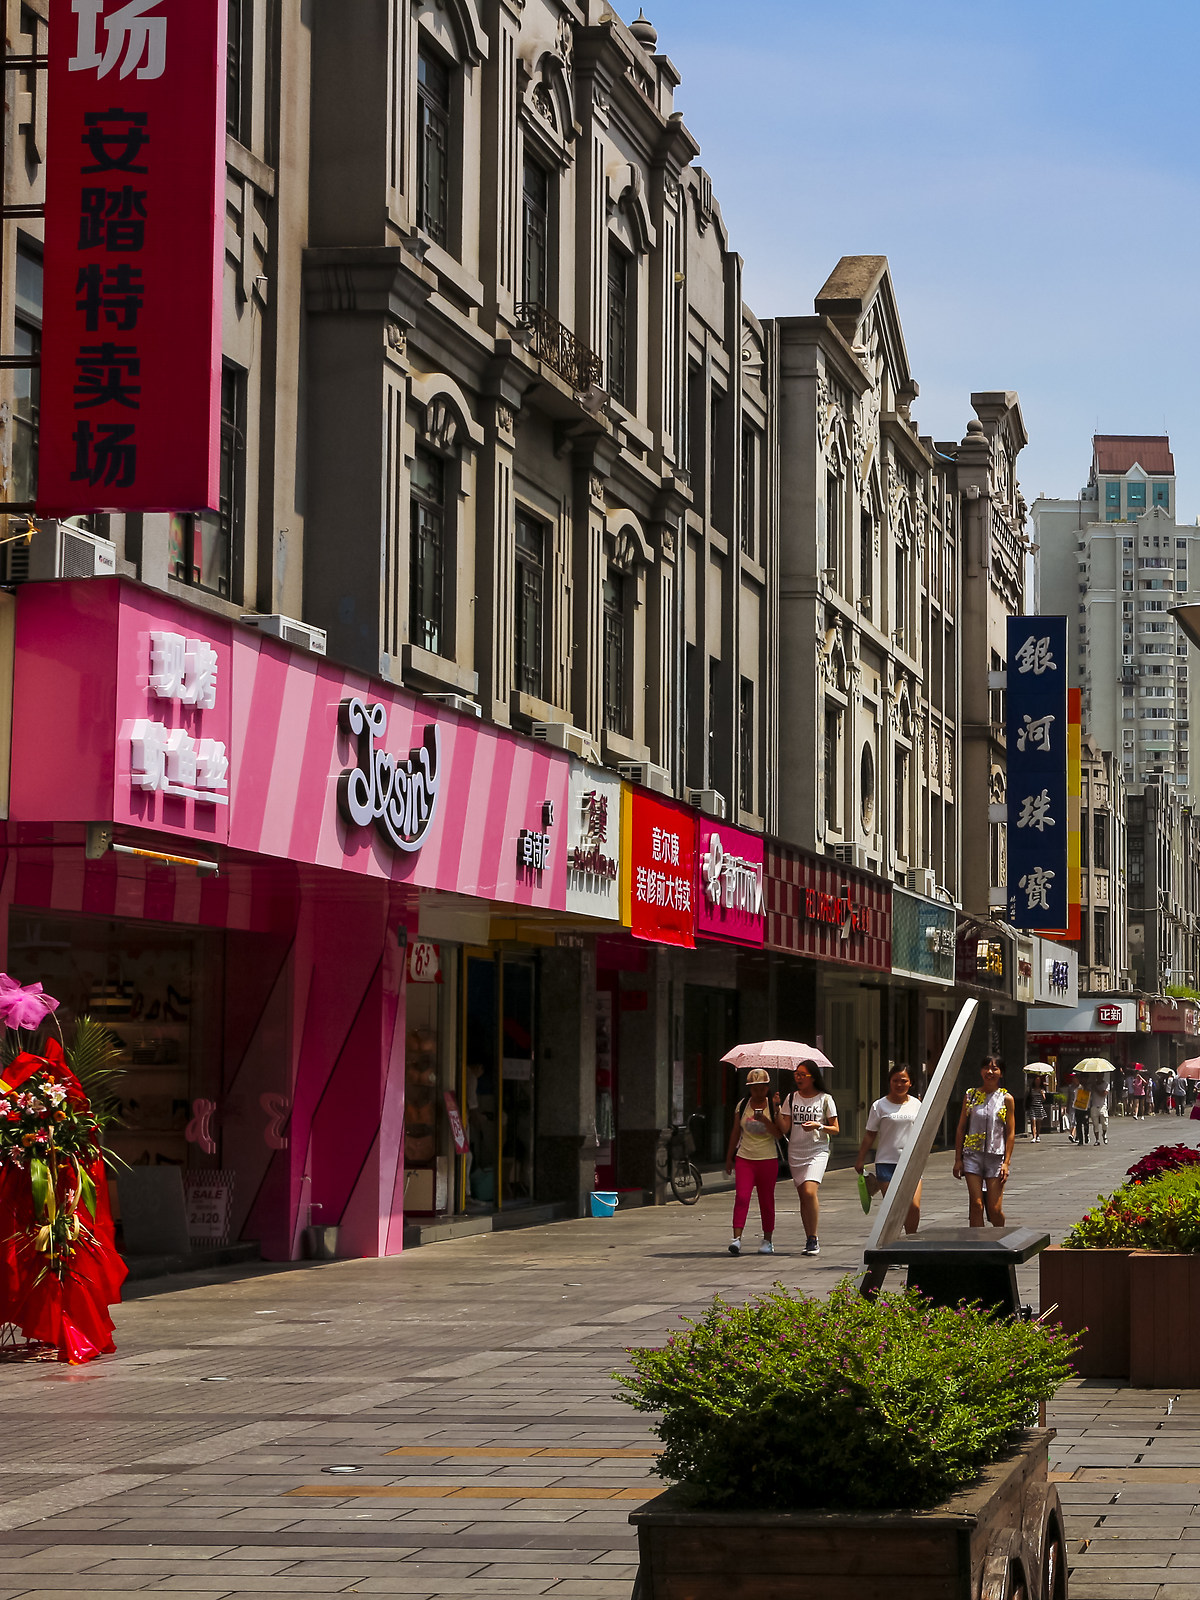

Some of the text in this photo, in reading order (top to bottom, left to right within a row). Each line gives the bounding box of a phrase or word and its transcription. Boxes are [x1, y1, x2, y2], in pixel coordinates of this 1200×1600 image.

[70, 107, 150, 489] 安踏特卖场
[651, 827, 680, 867] 意尔康
[636, 866, 692, 912] 装修前大特卖
[1100, 1008, 1121, 1021] 正新
[794, 1104, 819, 1114] ROCK
[192, 1190, 223, 1199] SALE
